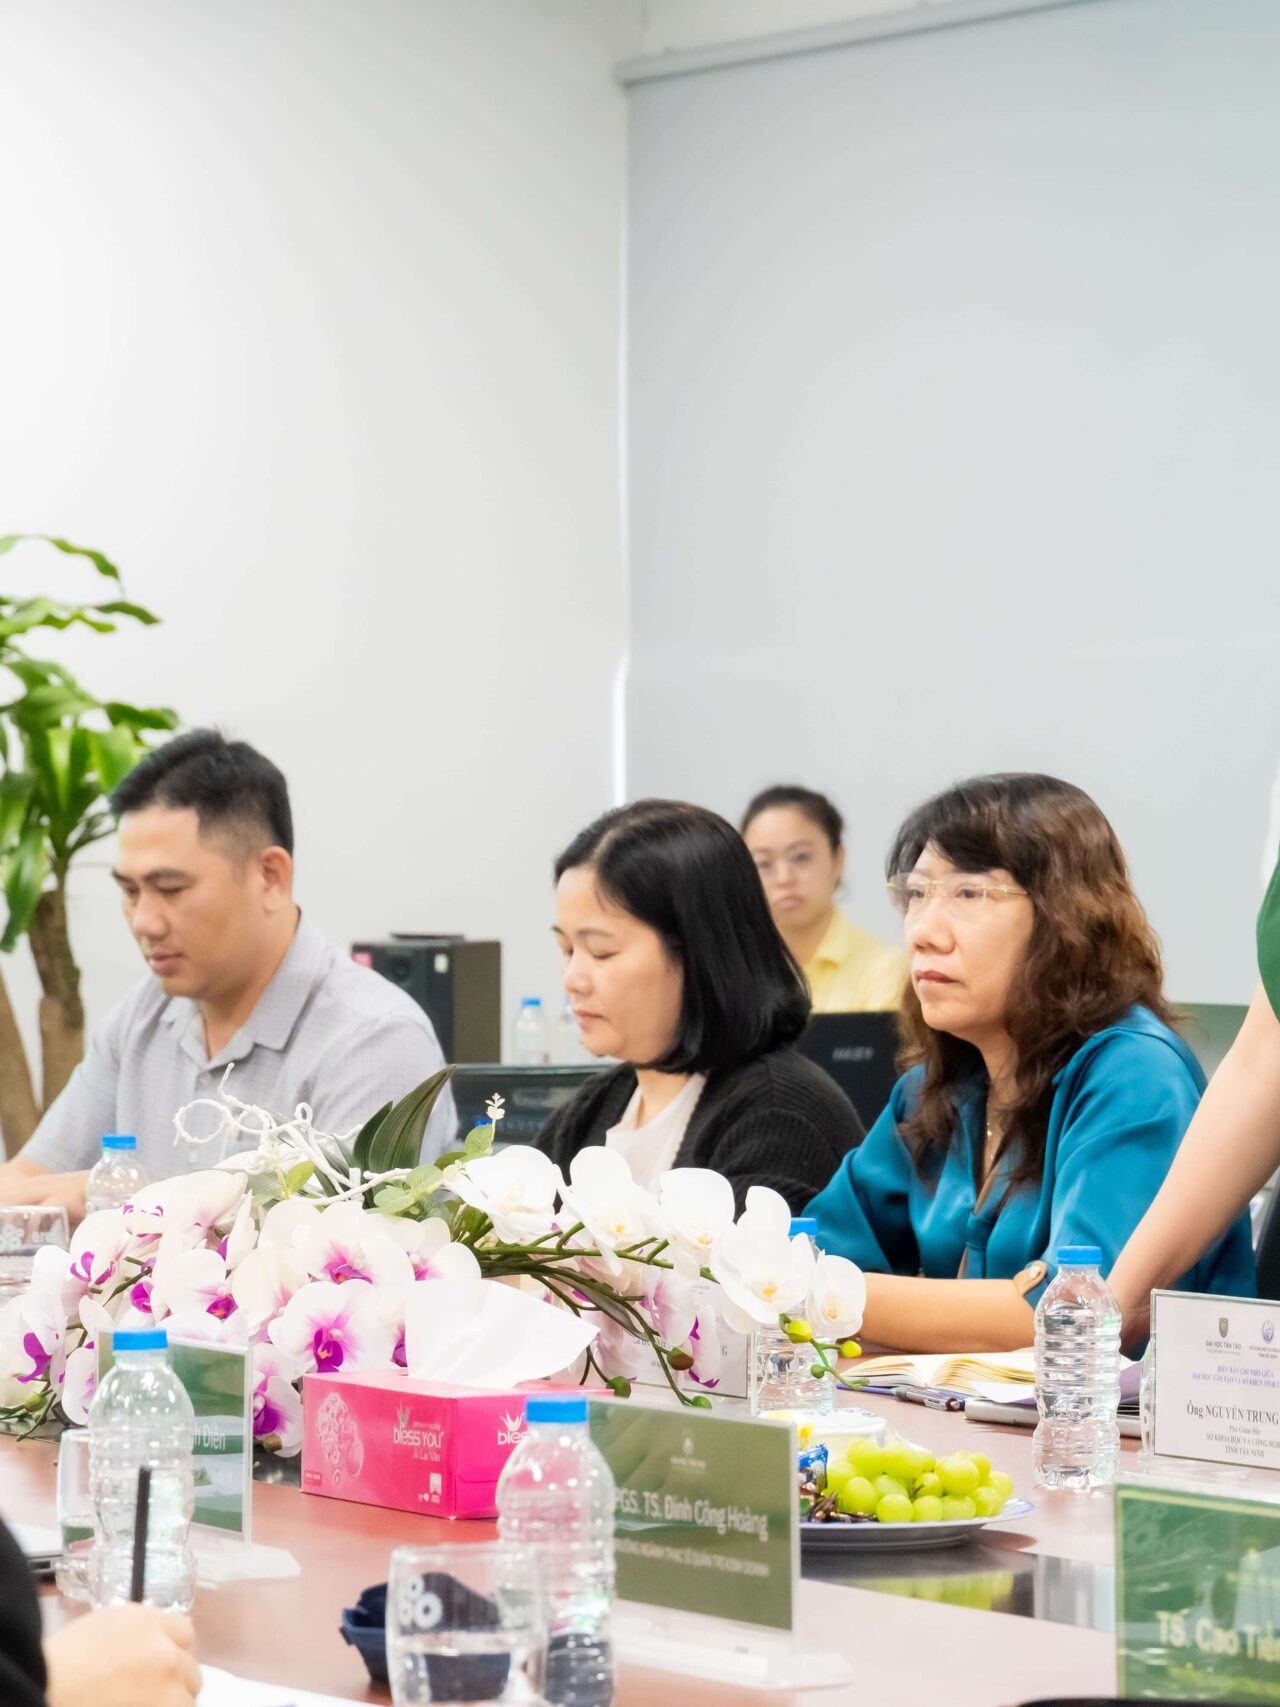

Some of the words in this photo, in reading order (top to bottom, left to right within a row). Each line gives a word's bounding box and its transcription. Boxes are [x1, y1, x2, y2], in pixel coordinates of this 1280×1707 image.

[1187, 1399, 1204, 1420] Ông
[1247, 1408, 1279, 1425] TRUNG
[394, 1425, 421, 1446] bless
[642, 1491, 662, 1518] TS.
[694, 1499, 726, 1535] Công
[1195, 1617, 1240, 1656] Cao
